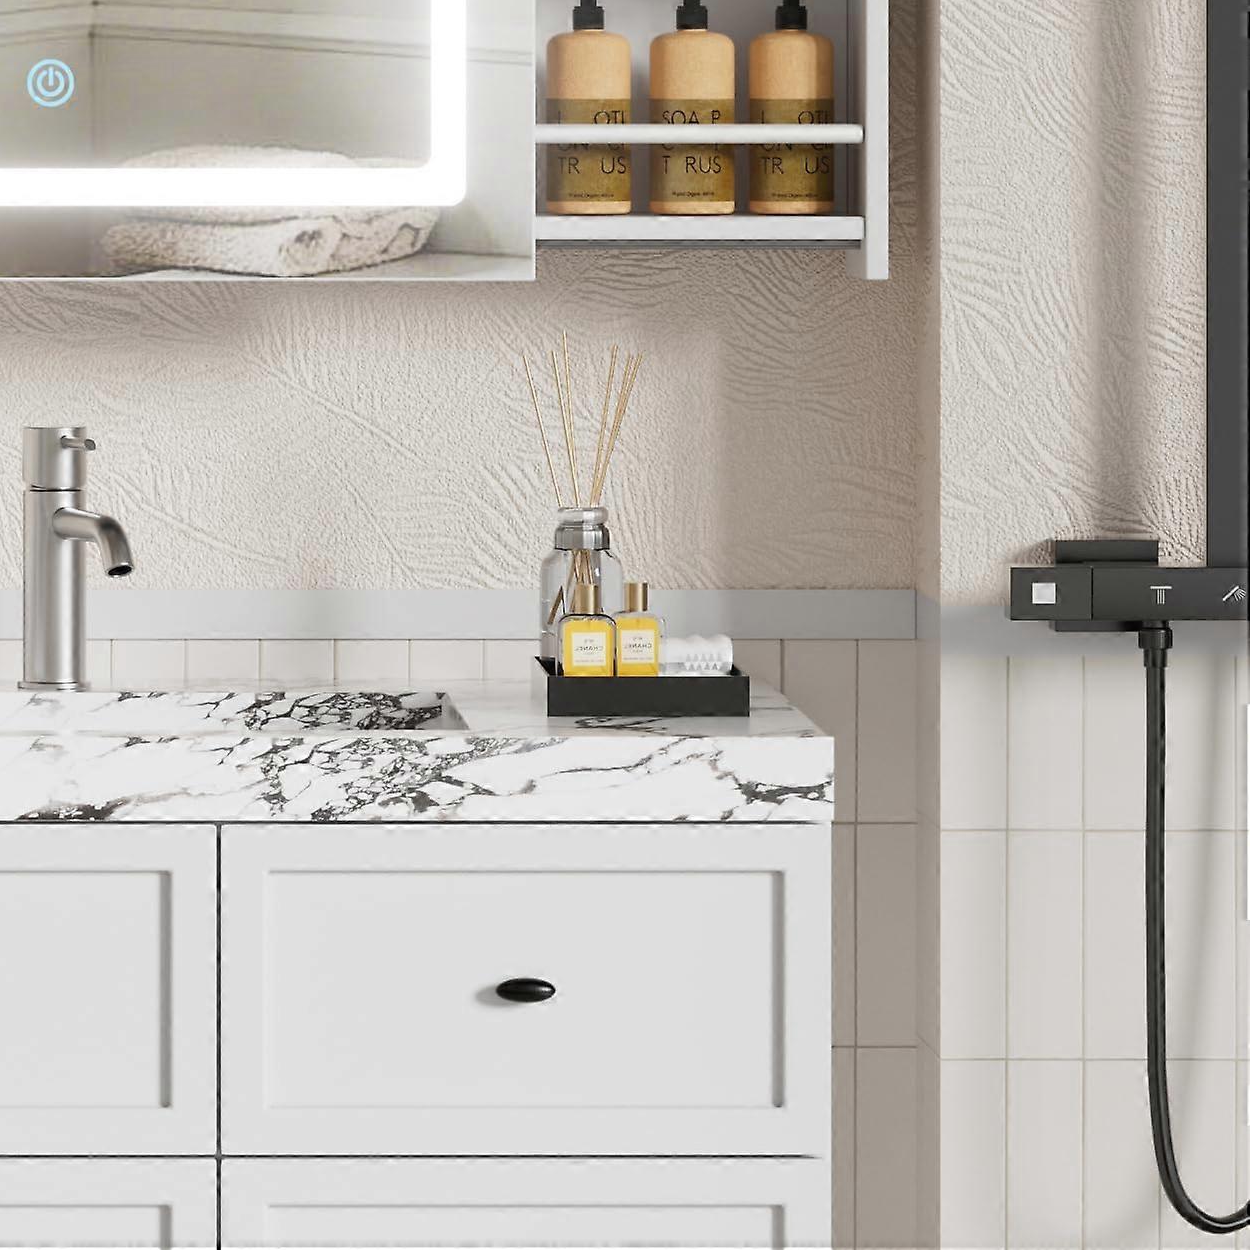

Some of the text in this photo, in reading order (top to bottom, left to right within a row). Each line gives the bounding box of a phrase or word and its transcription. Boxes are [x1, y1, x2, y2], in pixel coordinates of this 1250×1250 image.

[557, 155, 627, 175] TR US
[661, 155, 723, 175] T RUS
[761, 155, 831, 175] TR US
